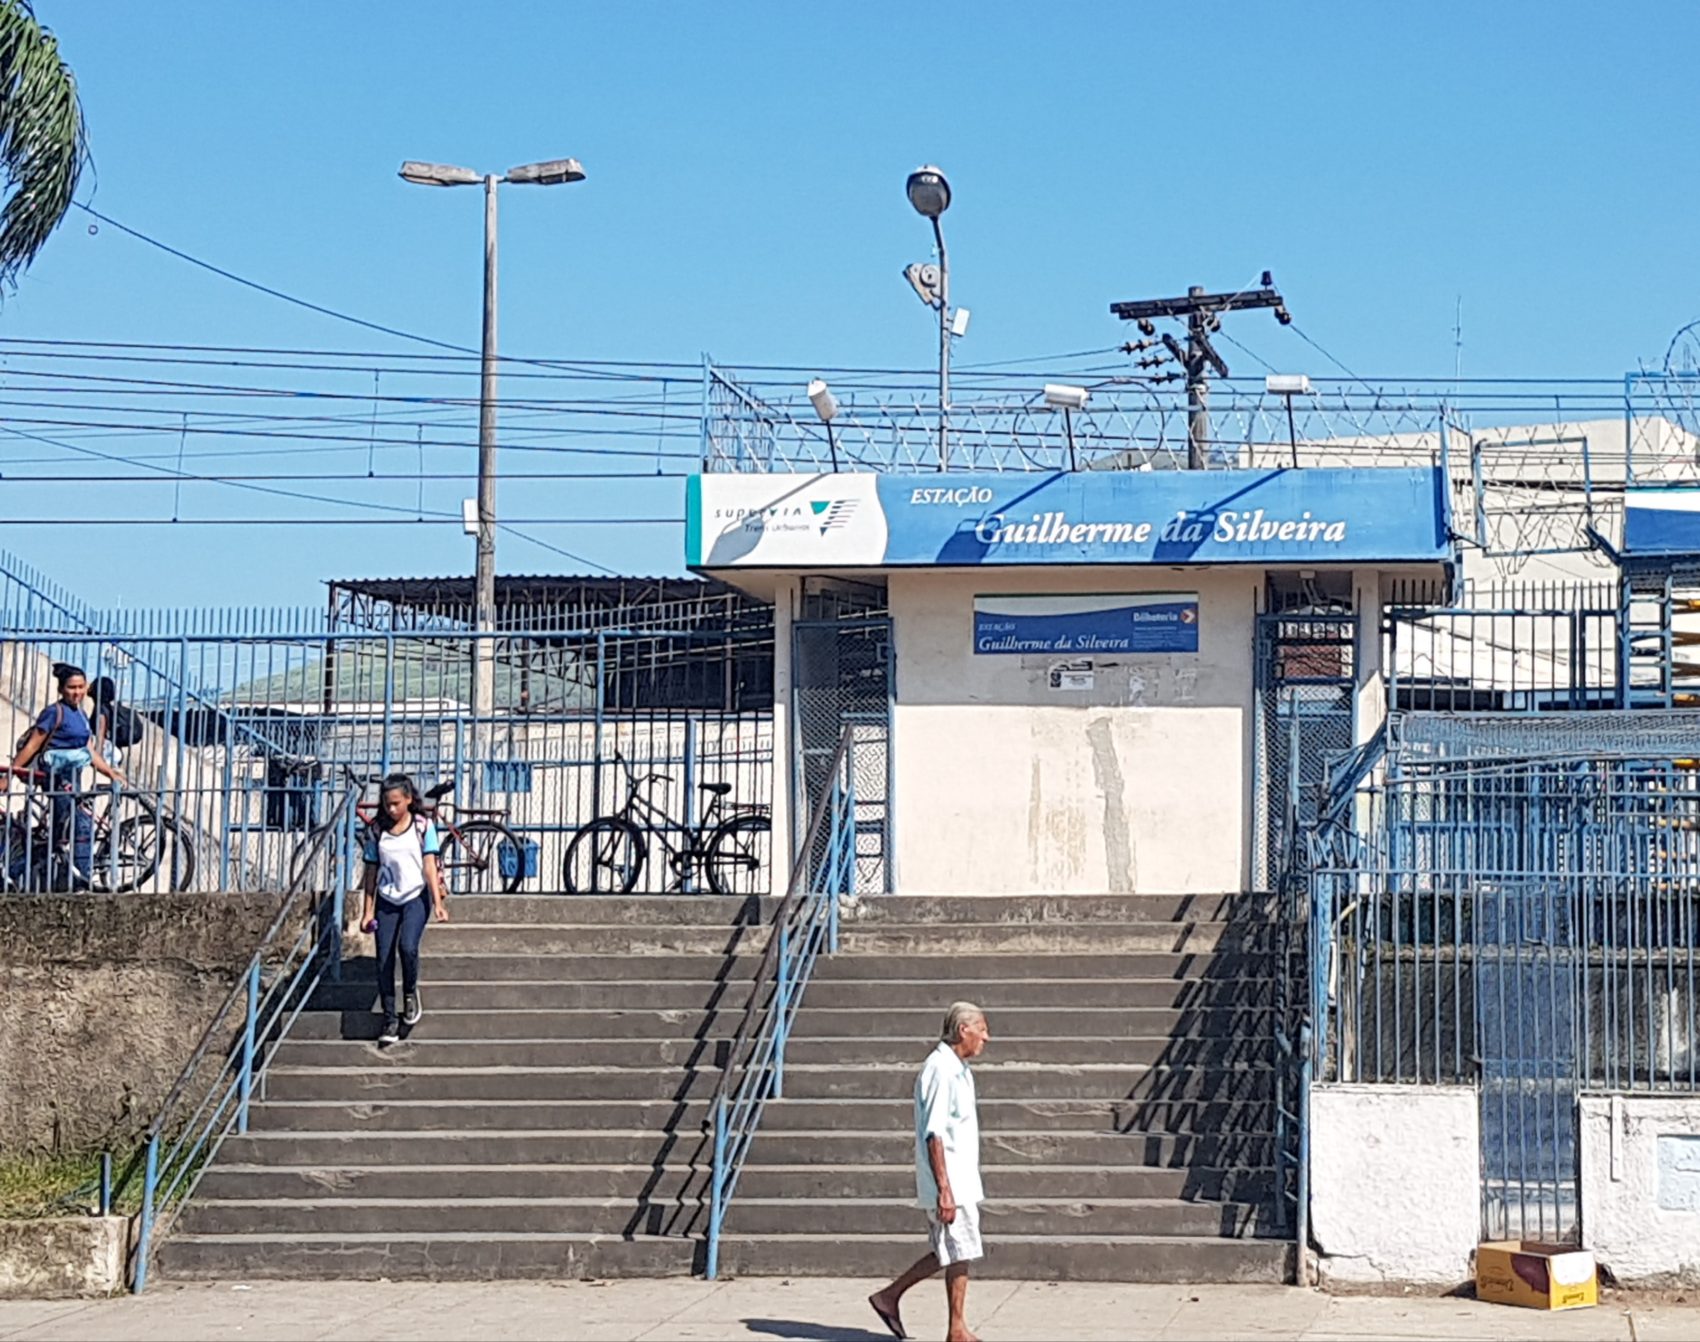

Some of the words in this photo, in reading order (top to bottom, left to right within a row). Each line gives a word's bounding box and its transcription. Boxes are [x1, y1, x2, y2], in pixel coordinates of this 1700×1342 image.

[911, 486, 992, 507] ESTAÇÃO
[975, 511, 1151, 543] Guilherme
[1161, 511, 1203, 542] da
[1214, 509, 1345, 542] Silveira
[979, 635, 1050, 650] Guilherme
[1054, 634, 1072, 649] da
[1078, 634, 1129, 649] Silveira
